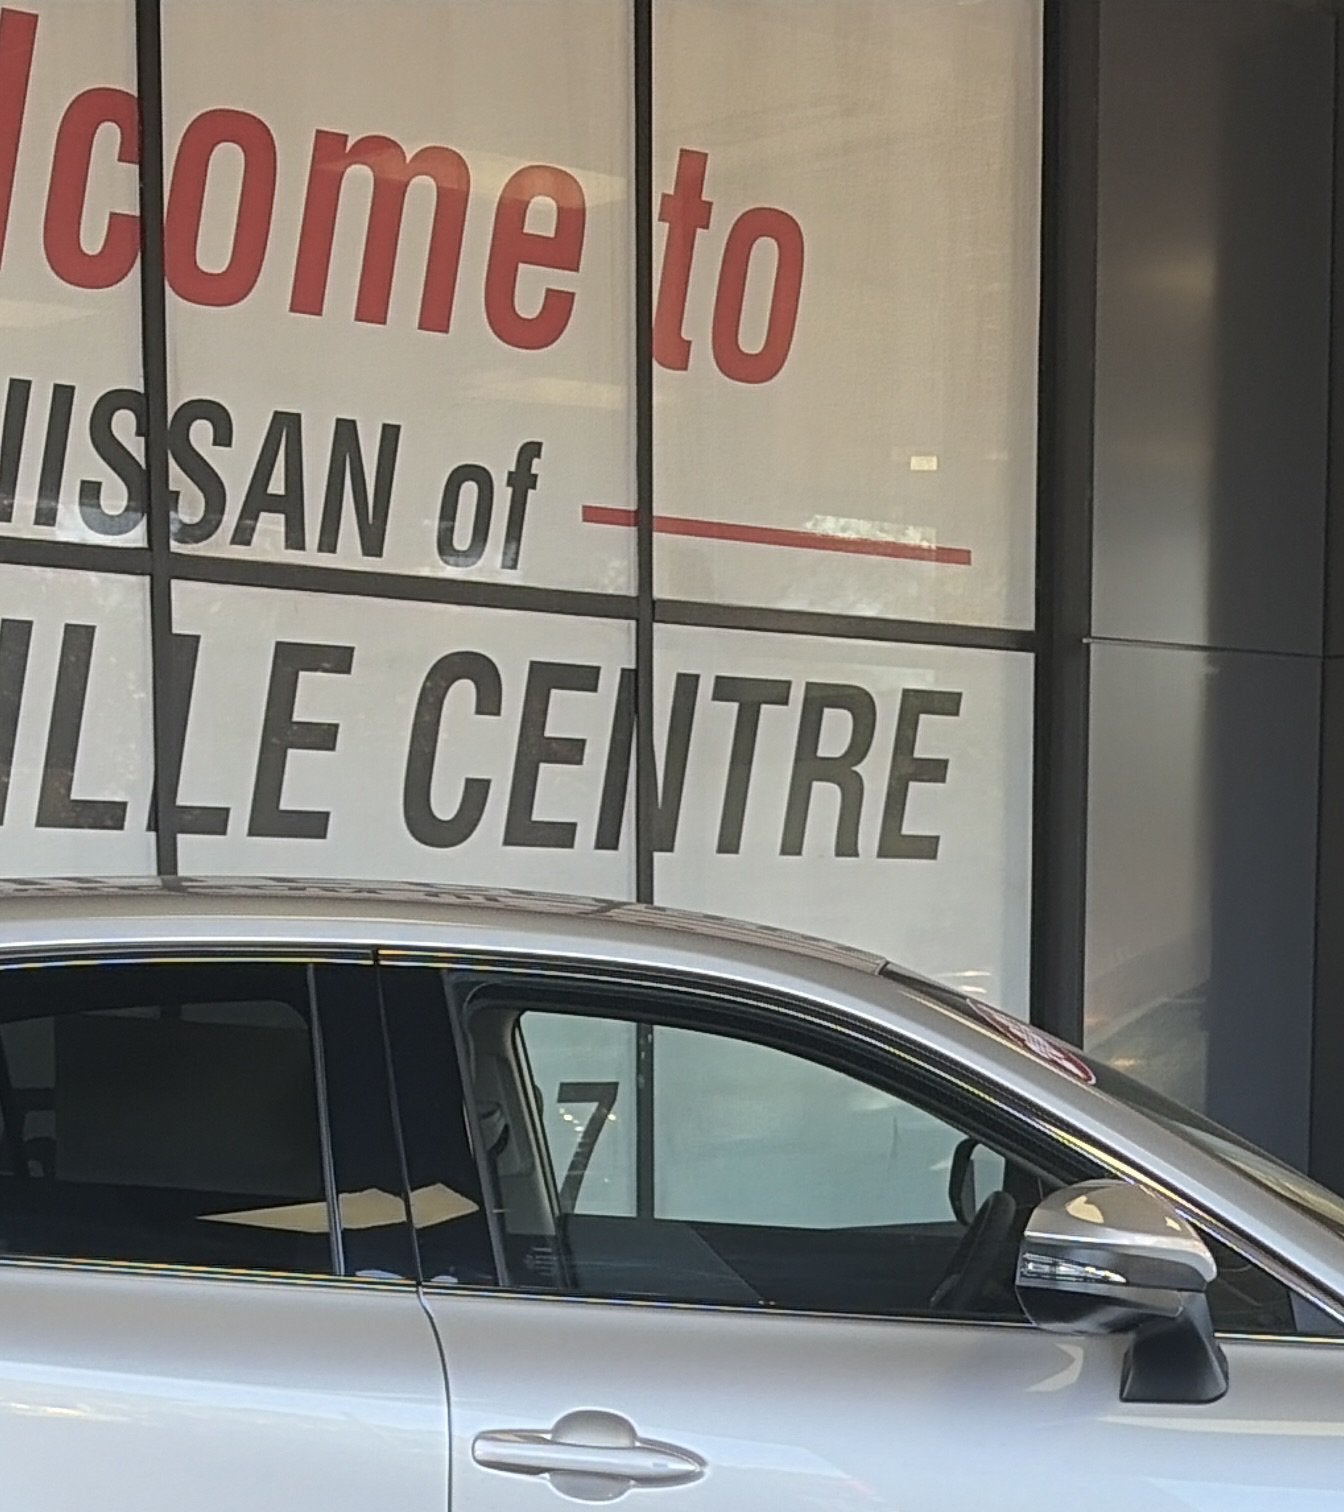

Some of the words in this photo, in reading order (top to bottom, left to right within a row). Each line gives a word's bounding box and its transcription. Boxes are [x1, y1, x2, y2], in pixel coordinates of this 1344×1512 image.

[652, 148, 805, 385] to
[435, 441, 543, 571] of
[402, 650, 963, 861] CENTRE
